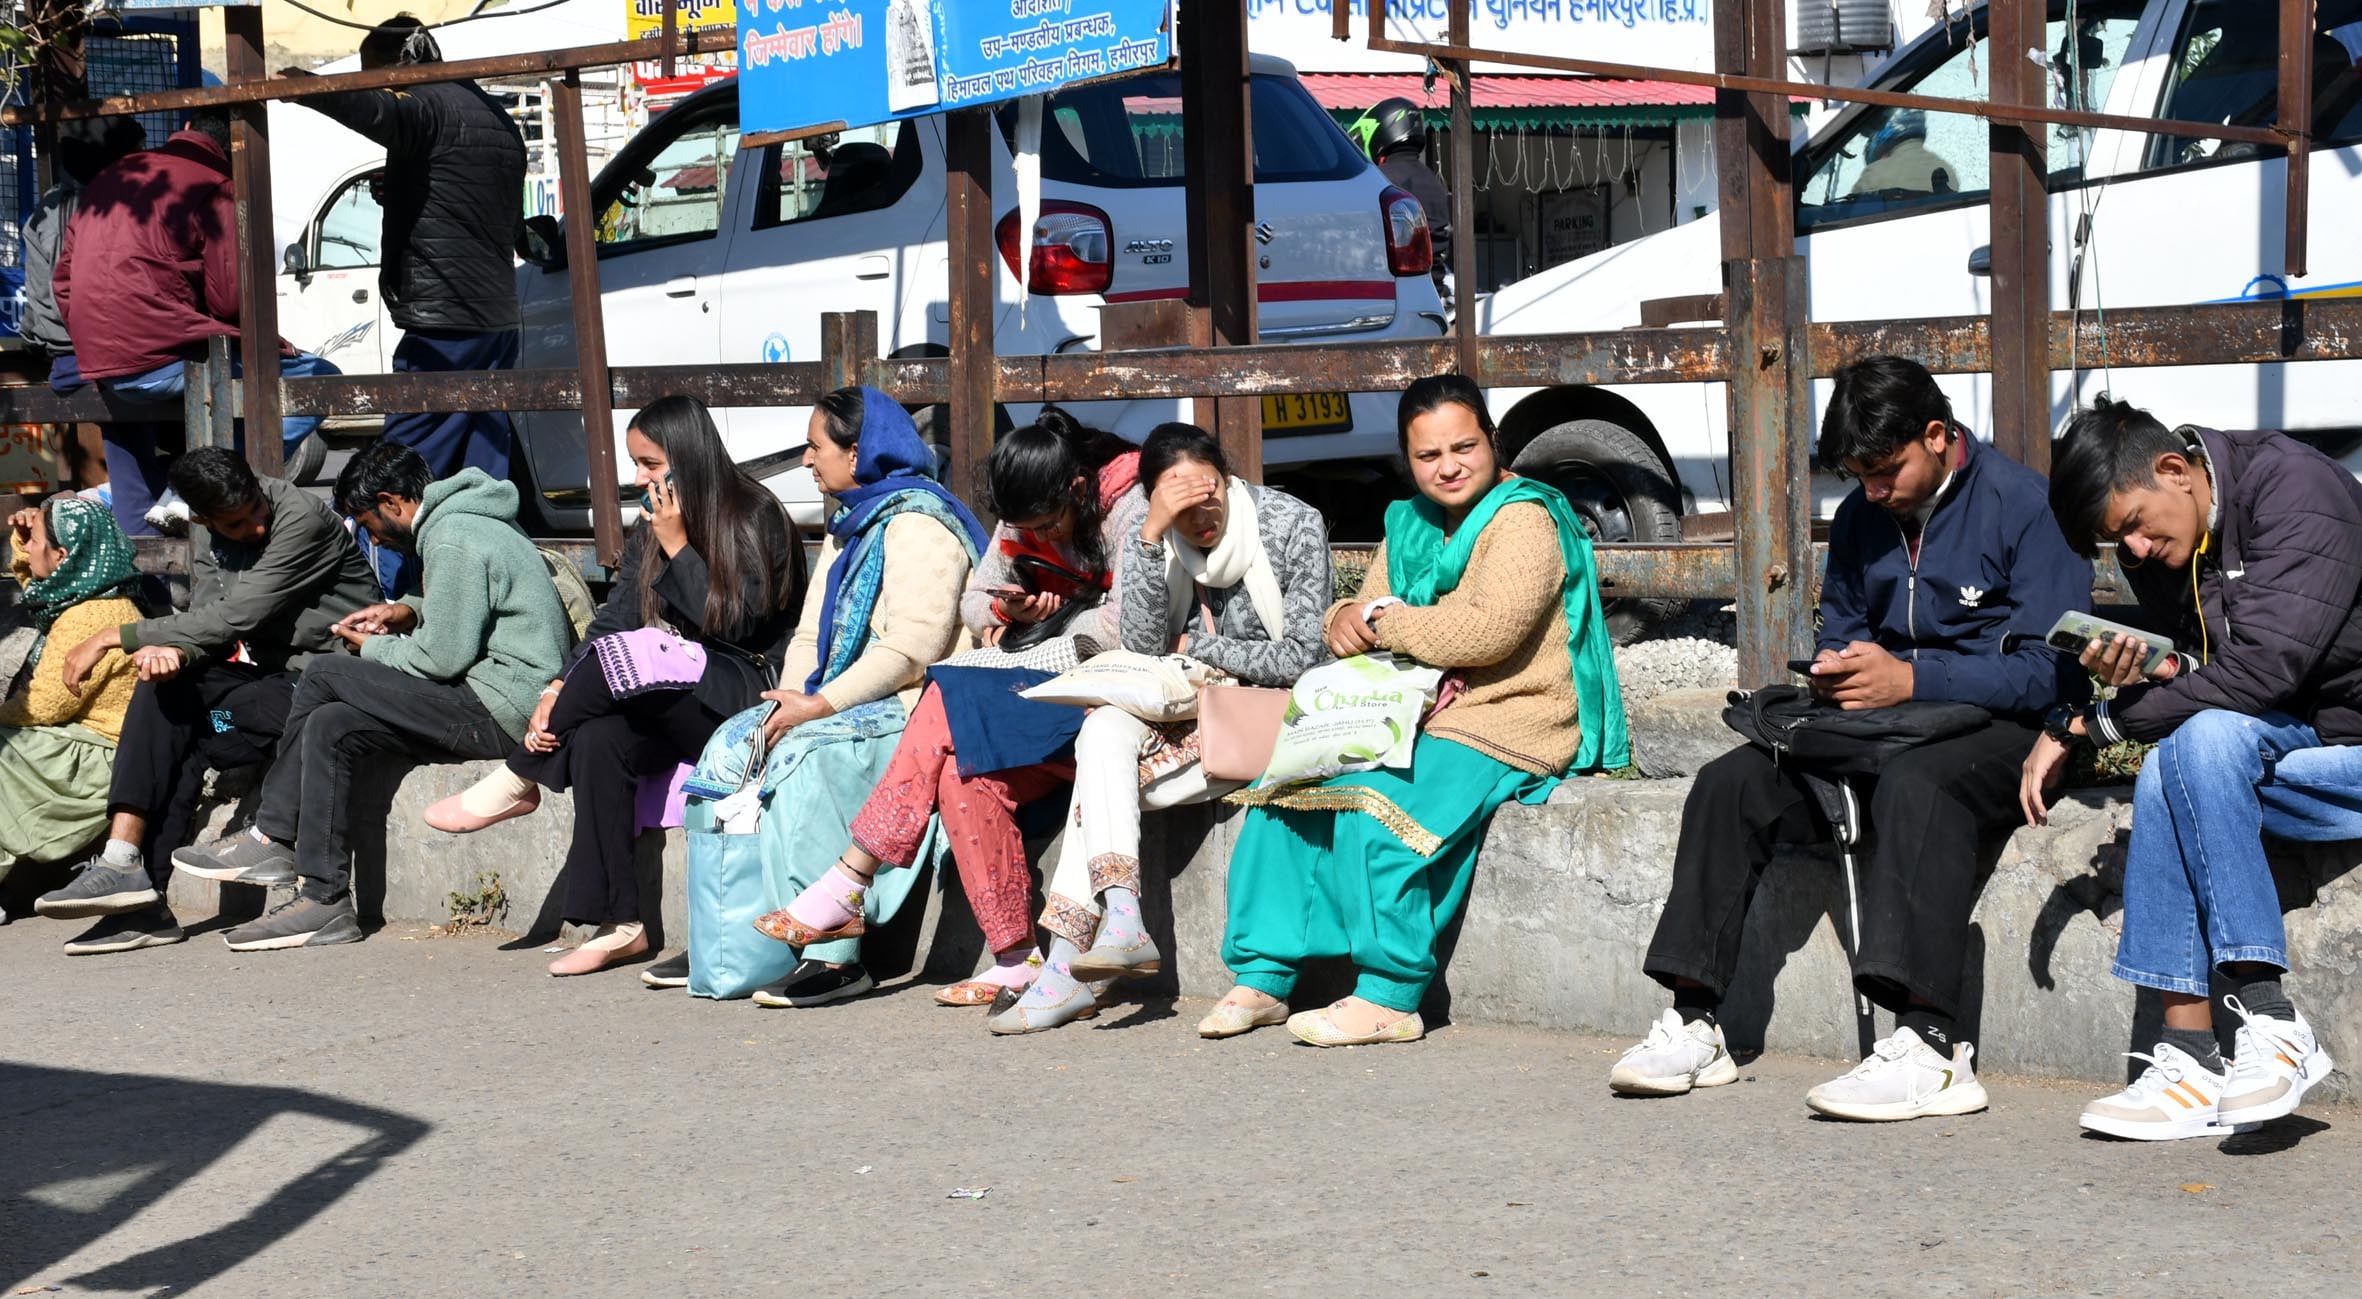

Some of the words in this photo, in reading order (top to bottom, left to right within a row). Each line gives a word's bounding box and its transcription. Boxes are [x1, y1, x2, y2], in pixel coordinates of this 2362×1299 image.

[946, 74, 992, 101] हिमाचल
[994, 68, 1015, 90] पथ
[1018, 58, 1063, 86] परिवहन
[1108, 37, 1157, 67] हमीरपुर
[1553, 214, 1594, 232] PARKING
